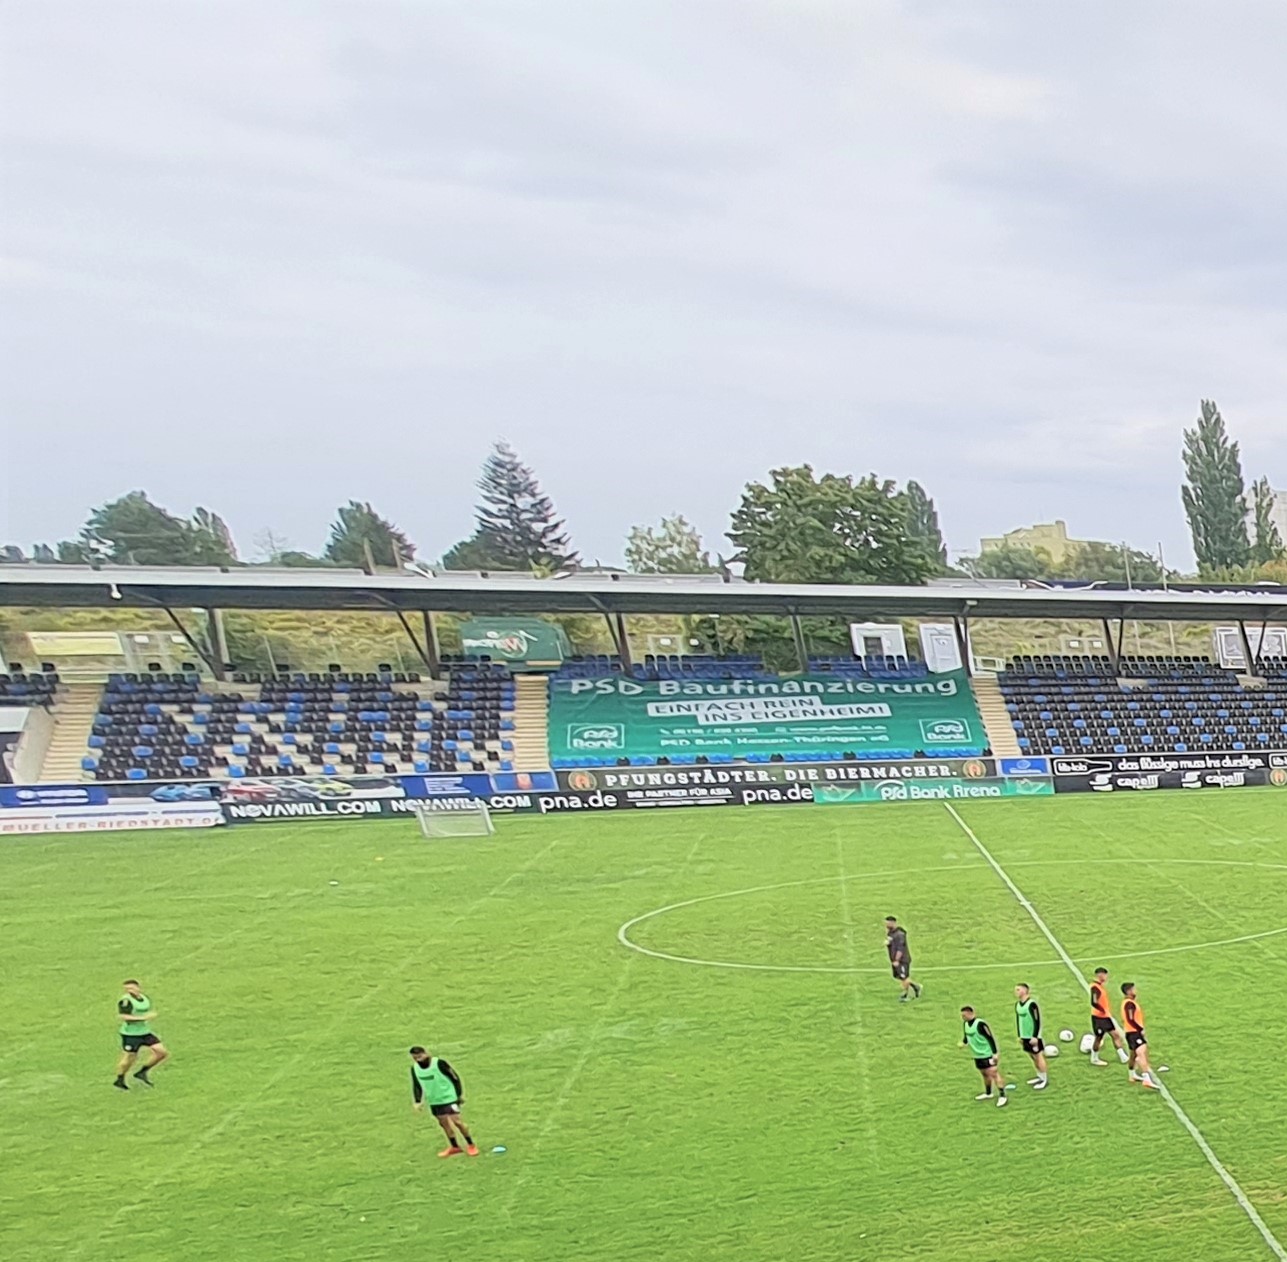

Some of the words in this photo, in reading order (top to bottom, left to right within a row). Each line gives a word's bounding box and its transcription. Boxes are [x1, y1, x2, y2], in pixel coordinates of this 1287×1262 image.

[571, 679, 644, 695] PSD
[659, 678, 958, 696] Baufinanzierung
[654, 701, 755, 714] EINFACH
[763, 698, 814, 709] REIN
[705, 711, 743, 722] INS
[751, 706, 885, 721] EIGENHEIM!
[604, 769, 777, 787] PFUNGSTÄDTER.
[784, 768, 819, 781] DIE
[742, 783, 814, 806] pna.de
[911, 784, 950, 799] Bank
[953, 784, 1001, 798] Arena
[231, 800, 381, 817] NOVAWILL.COM
[539, 790, 618, 814] pna.de
